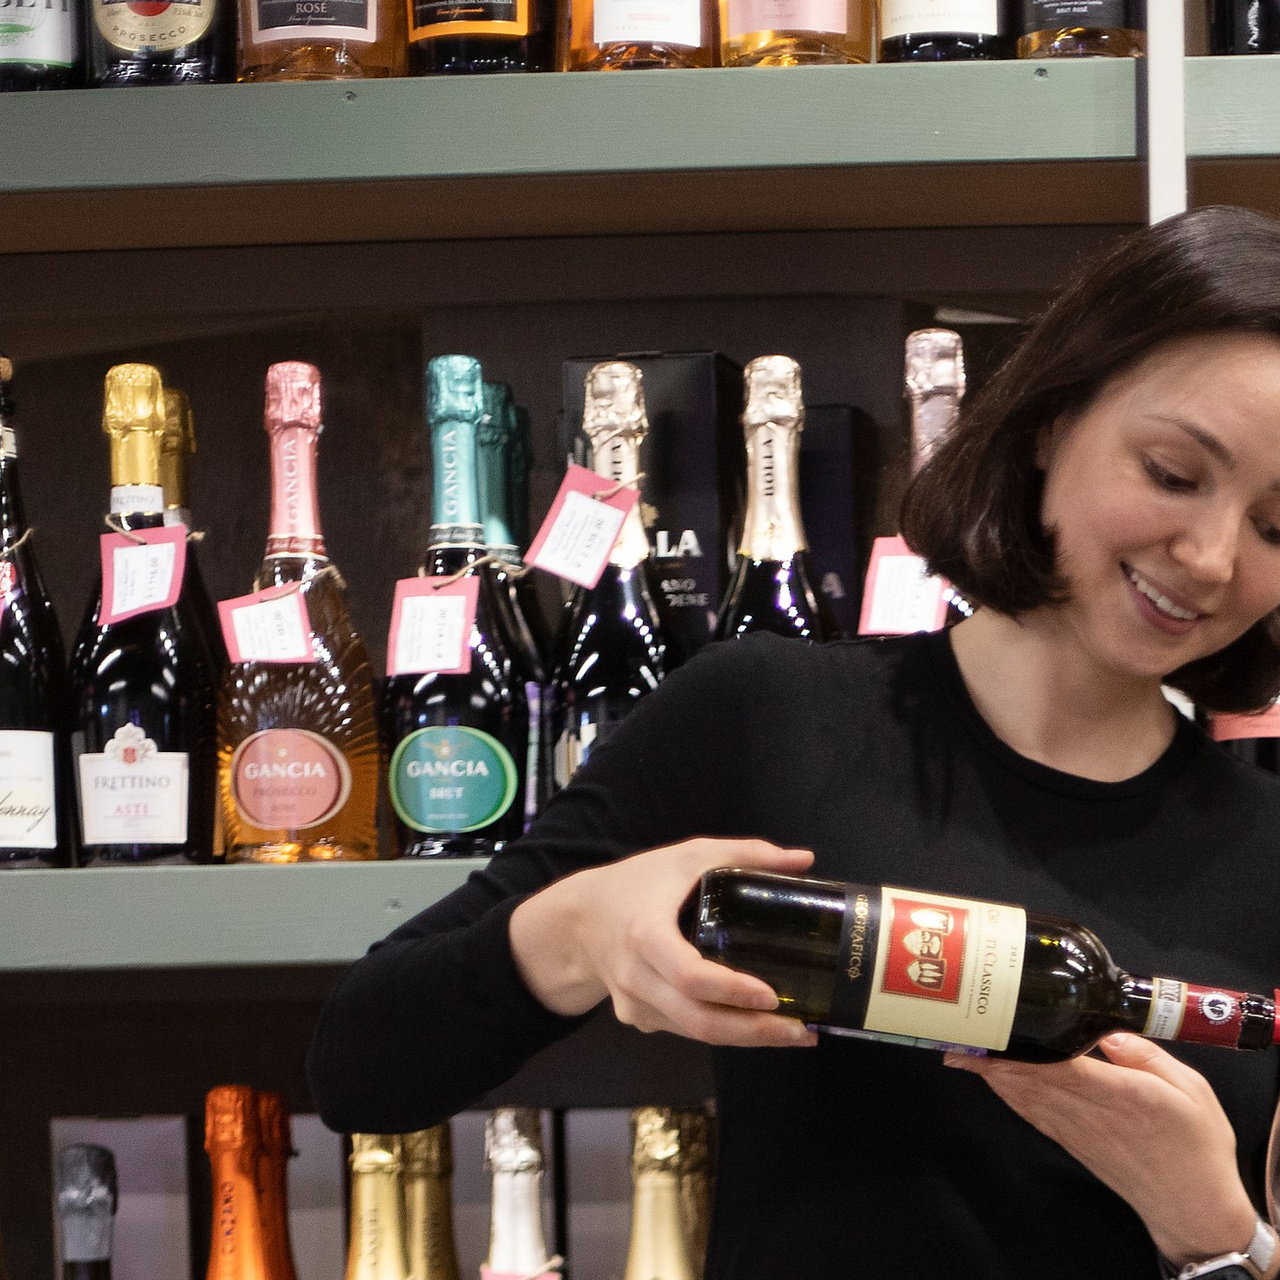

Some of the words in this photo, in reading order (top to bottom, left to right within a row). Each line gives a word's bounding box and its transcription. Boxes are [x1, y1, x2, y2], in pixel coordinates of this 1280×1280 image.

[112, 25, 186, 41] PROSECCO
[282, 439, 299, 525] GANCIA
[442, 430, 460, 516] GANCIA
[763, 439, 775, 496] BOLLA
[94, 775, 171, 790] FRETTINO
[244, 761, 327, 780] GANCIA
[406, 760, 490, 778] GANCIA
[113, 803, 150, 816] ASTI
[847, 894, 870, 981] GEOGRAFICO
[986, 908, 1002, 951] CHITI
[1008, 945, 1018, 969] 2021
[976, 951, 998, 1015] CLASSICO
